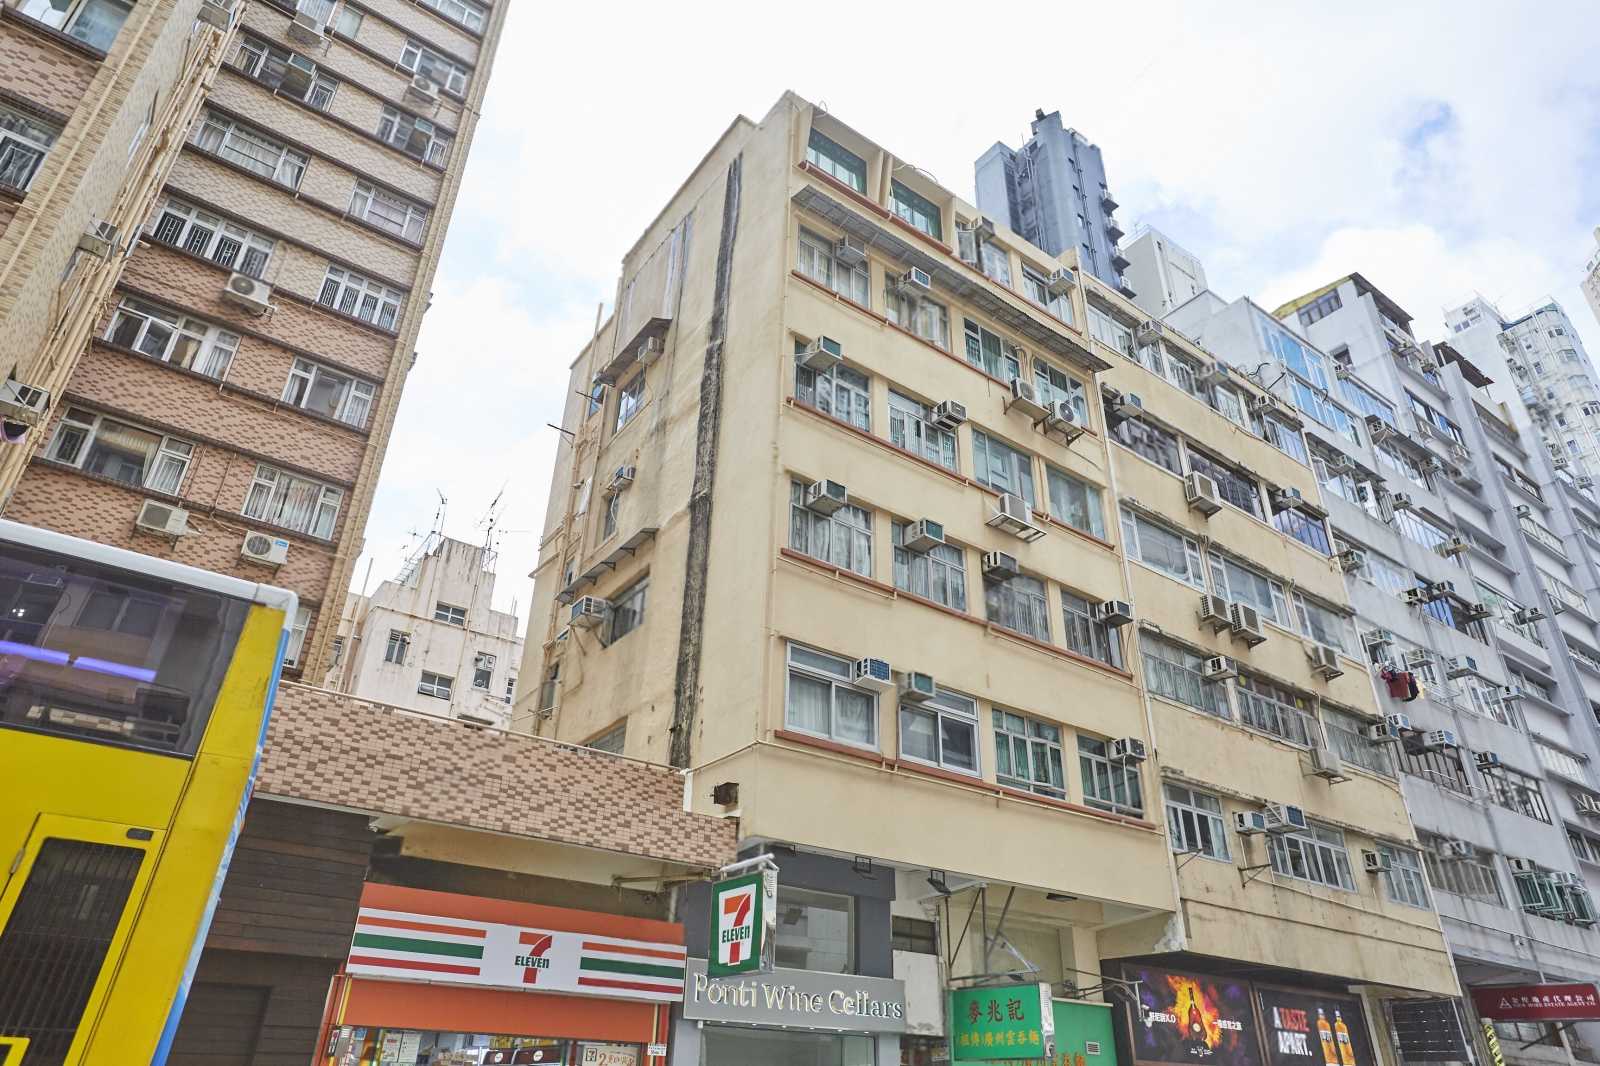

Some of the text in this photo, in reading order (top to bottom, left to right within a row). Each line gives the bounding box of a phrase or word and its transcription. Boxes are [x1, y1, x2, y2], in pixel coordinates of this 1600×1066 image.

[724, 893, 751, 966] 7
[519, 931, 553, 984] 7
[693, 972, 904, 1019] Ponti Wine Cellars
[1272, 1006, 1311, 1033] A TASTE
